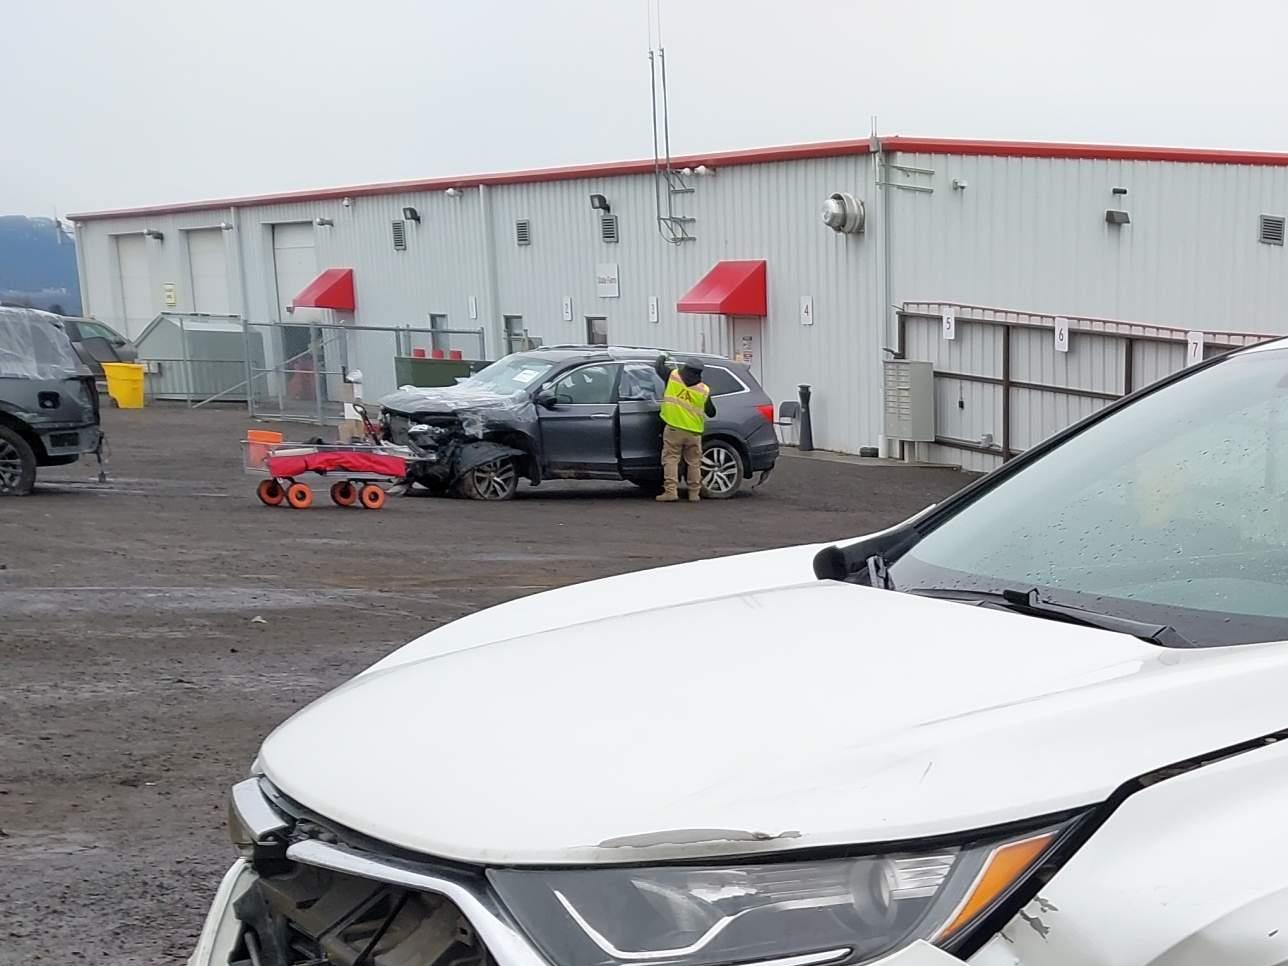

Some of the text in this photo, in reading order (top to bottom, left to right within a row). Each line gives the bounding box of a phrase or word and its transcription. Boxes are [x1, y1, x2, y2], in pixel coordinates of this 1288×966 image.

[945, 317, 951, 330] 5
[1058, 327, 1064, 342] 6
[1192, 342, 1199, 358] 7
